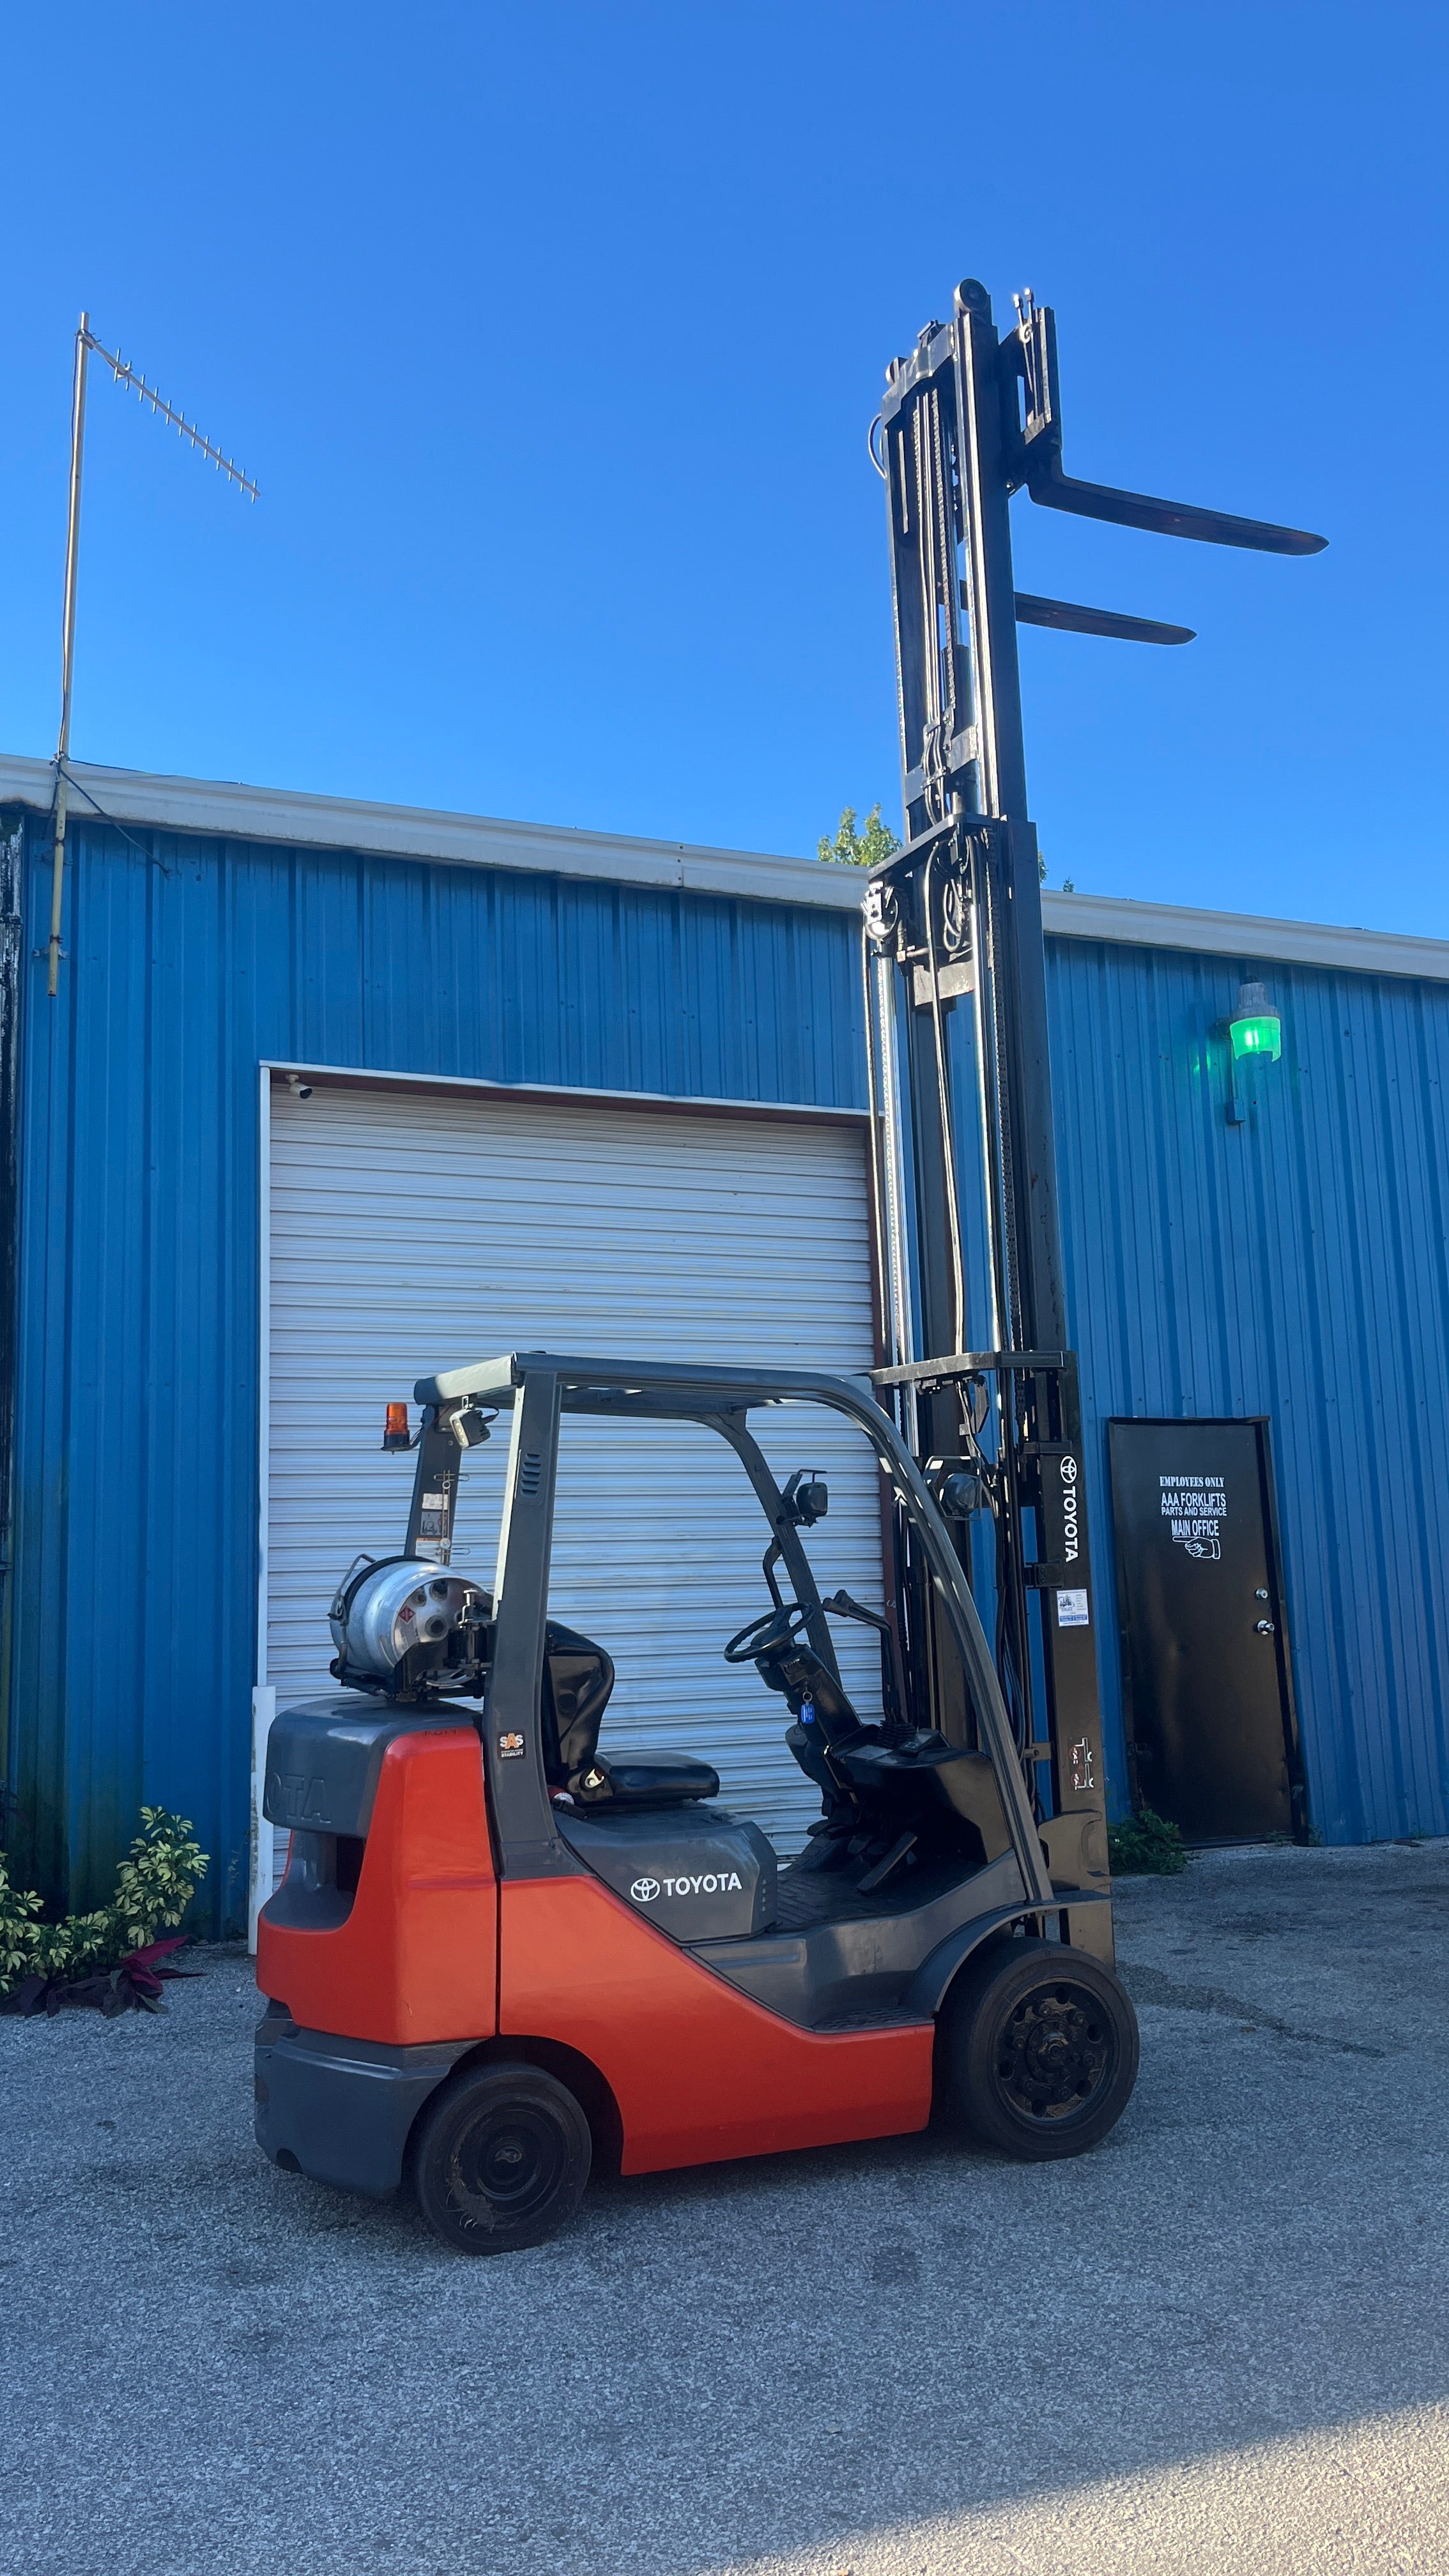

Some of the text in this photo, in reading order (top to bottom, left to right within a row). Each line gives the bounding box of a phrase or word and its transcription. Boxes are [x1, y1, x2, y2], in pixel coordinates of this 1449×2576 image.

[1159, 1476, 1225, 1488] EMPLOYEES ONLY
[1162, 1492, 1227, 1507] AAA FORKLIFTS
[1162, 1506, 1227, 1517] PARTS AND SERVICE
[1063, 1485, 1078, 1563] TOYOTA
[1171, 1519, 1220, 1537] MAIN OFFICE
[500, 1733, 524, 1749] SAS
[663, 1872, 743, 1897] TOYOTA
